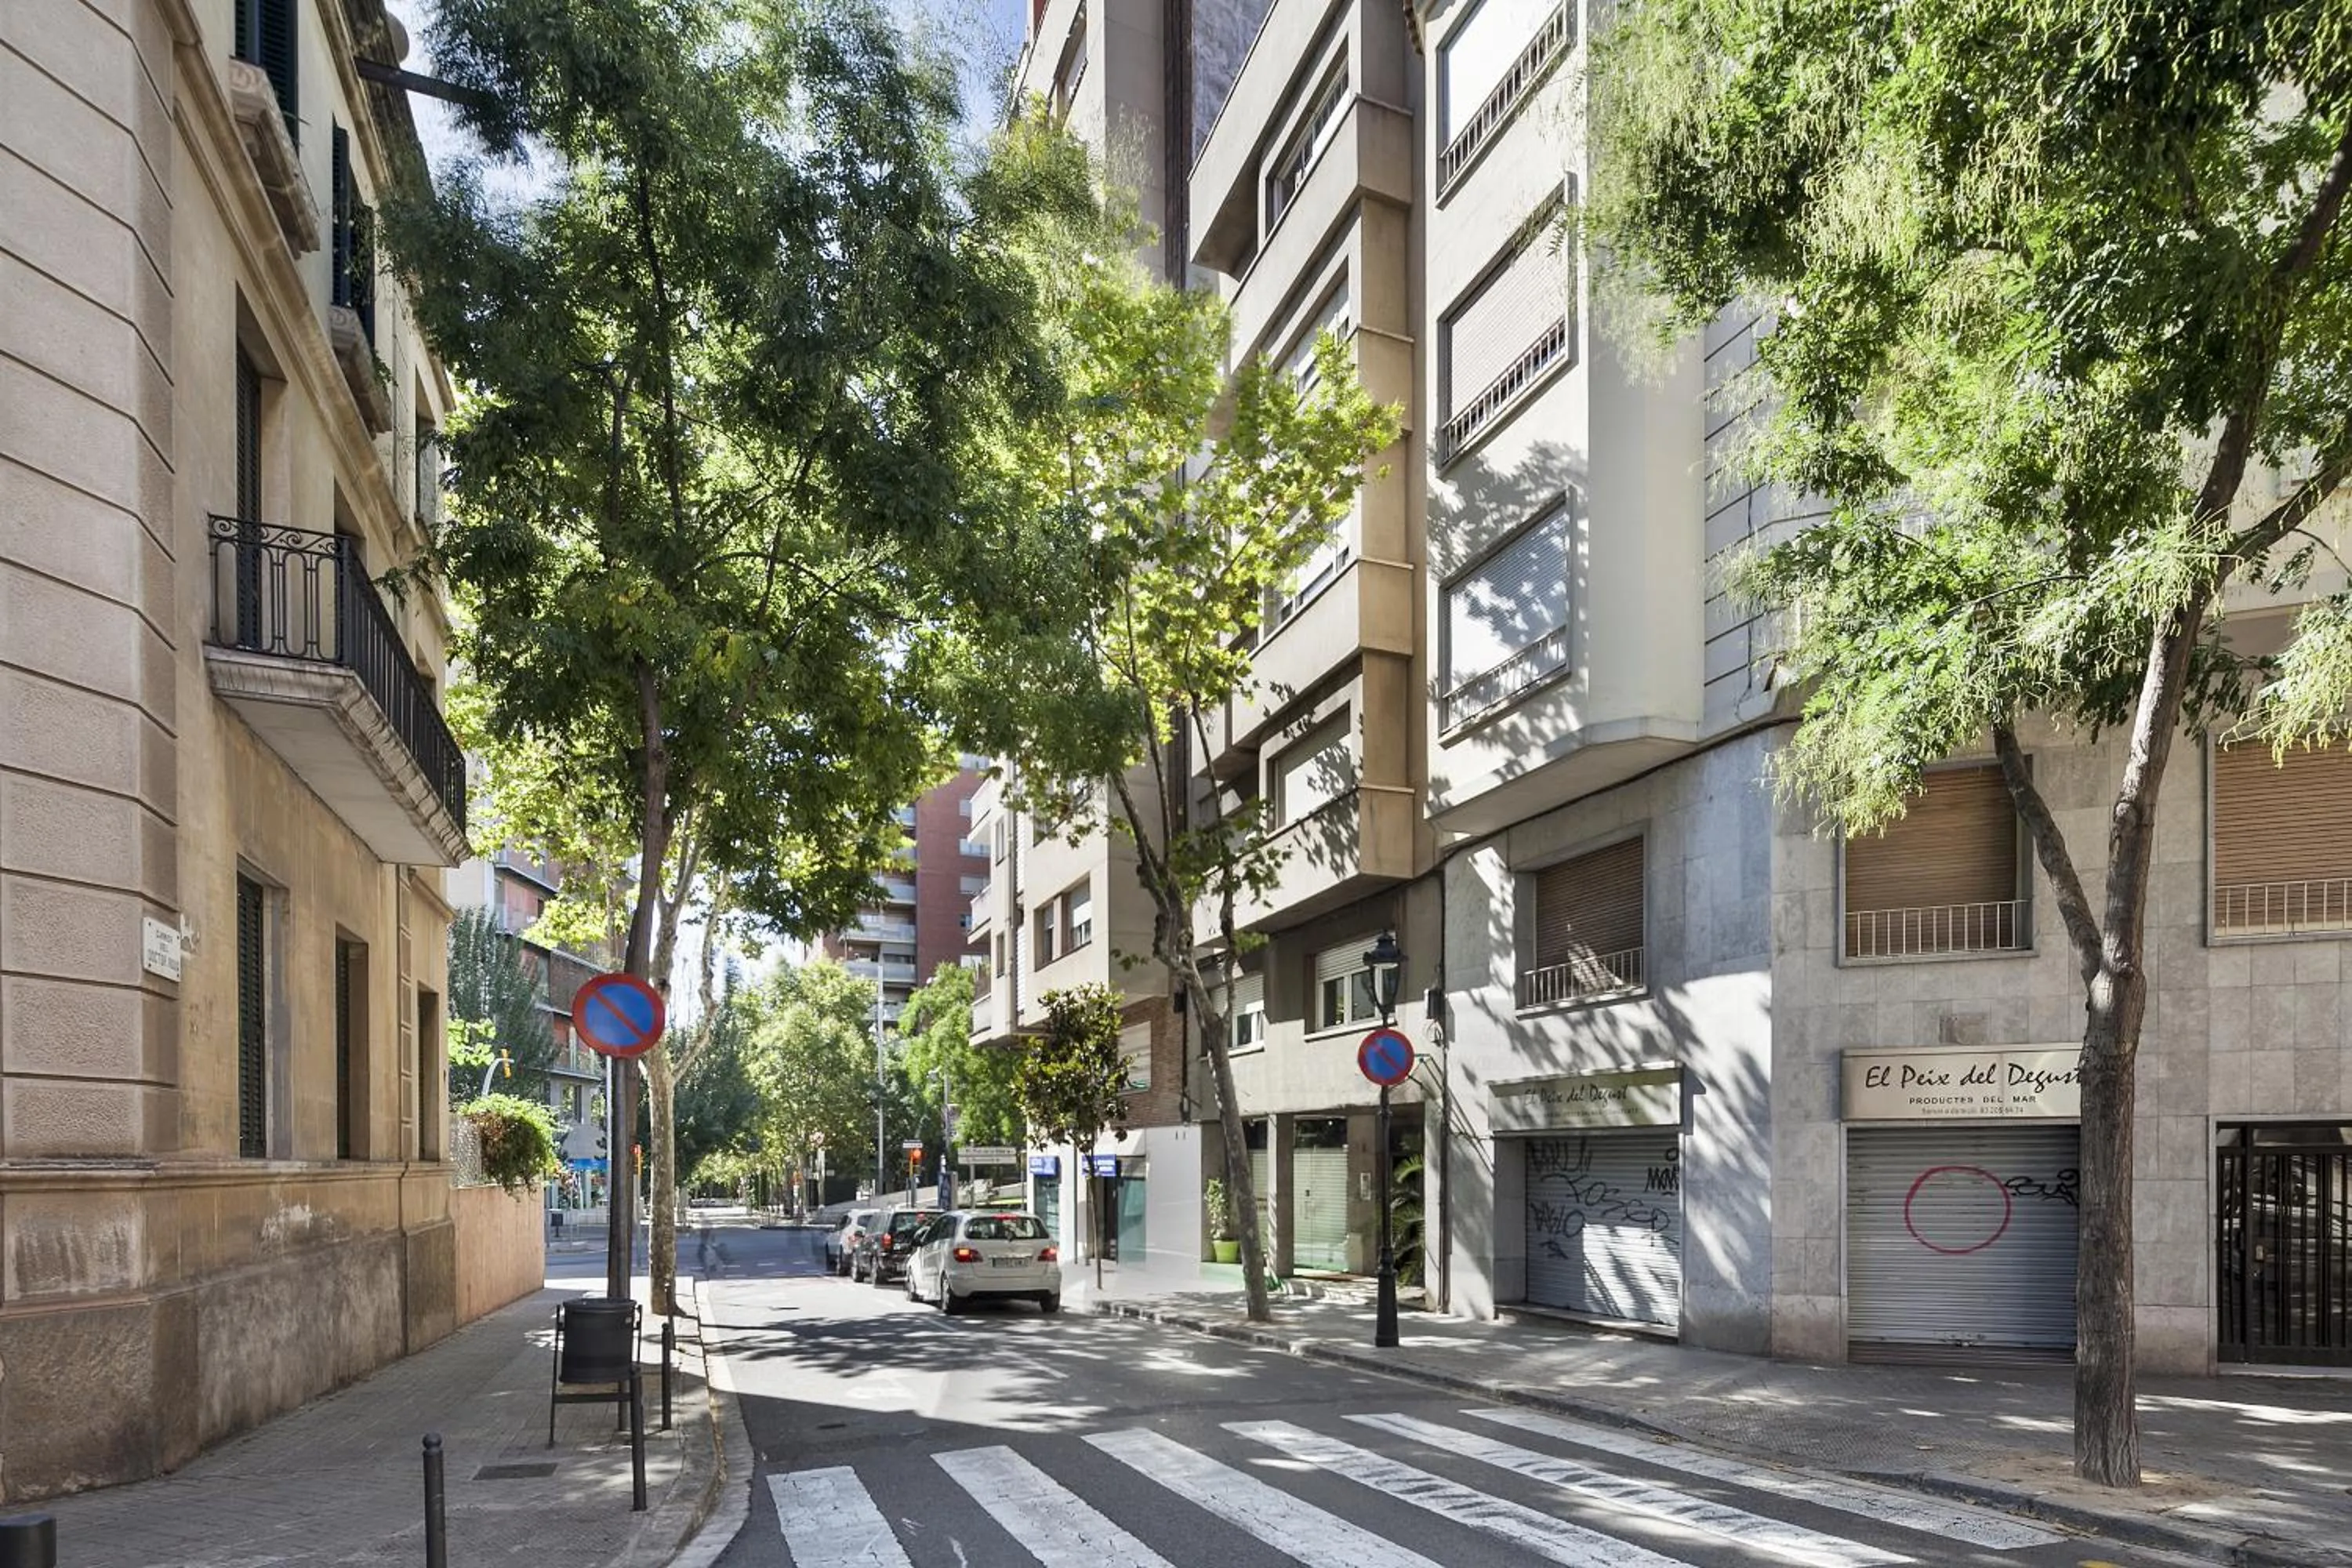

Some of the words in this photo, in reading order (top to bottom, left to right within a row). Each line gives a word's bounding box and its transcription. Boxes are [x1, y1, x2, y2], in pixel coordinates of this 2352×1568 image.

[1865, 1065, 1891, 1088] El
[1900, 1064, 1951, 1089] Peix
[1959, 1062, 1996, 1086] del
[1566, 1083, 1584, 1103] del
[1908, 1095, 1974, 1105] PRODUCTES
[1982, 1095, 2004, 1104] DEL
[2013, 1094, 2038, 1103] MAR
